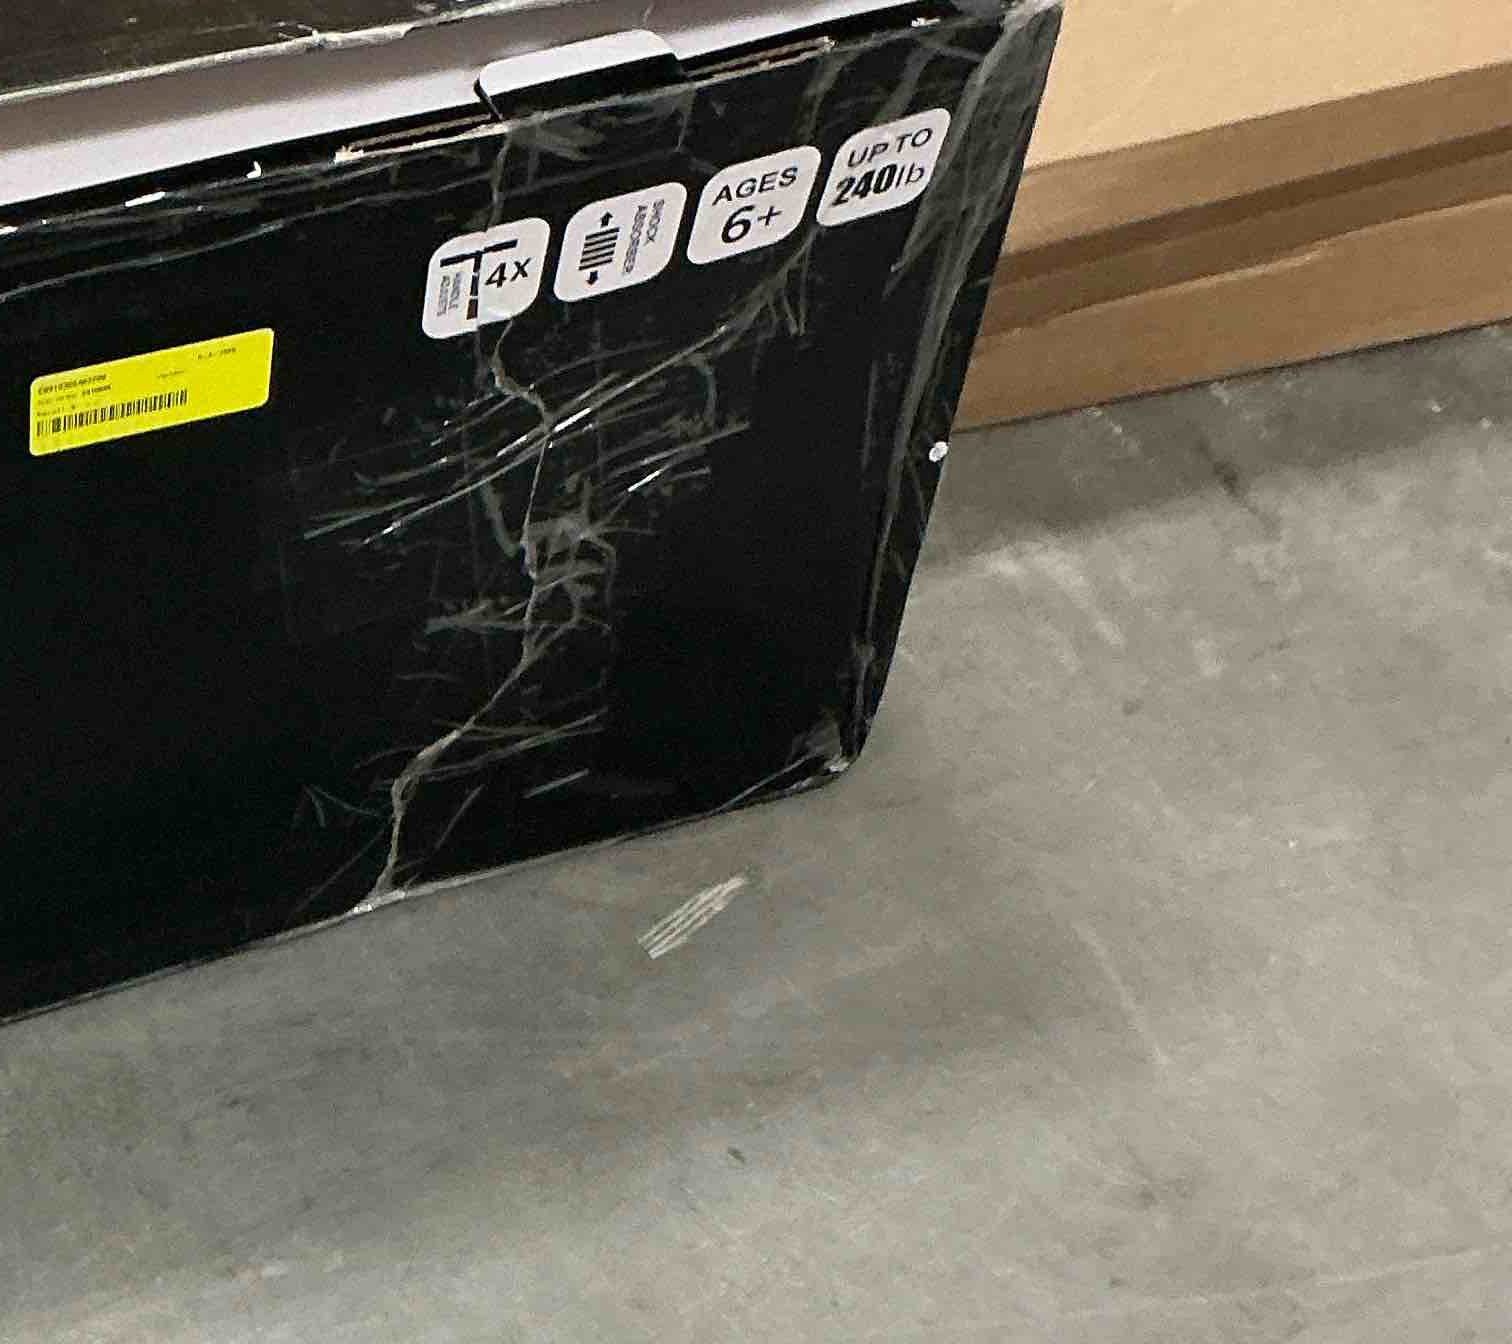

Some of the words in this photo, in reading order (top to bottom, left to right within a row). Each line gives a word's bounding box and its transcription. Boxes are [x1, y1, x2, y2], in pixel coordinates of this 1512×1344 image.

[848, 141, 888, 169] UP
[895, 127, 932, 154] TO
[711, 167, 798, 207] AGES
[831, 163, 925, 207] 240lb
[721, 205, 783, 244] 6+
